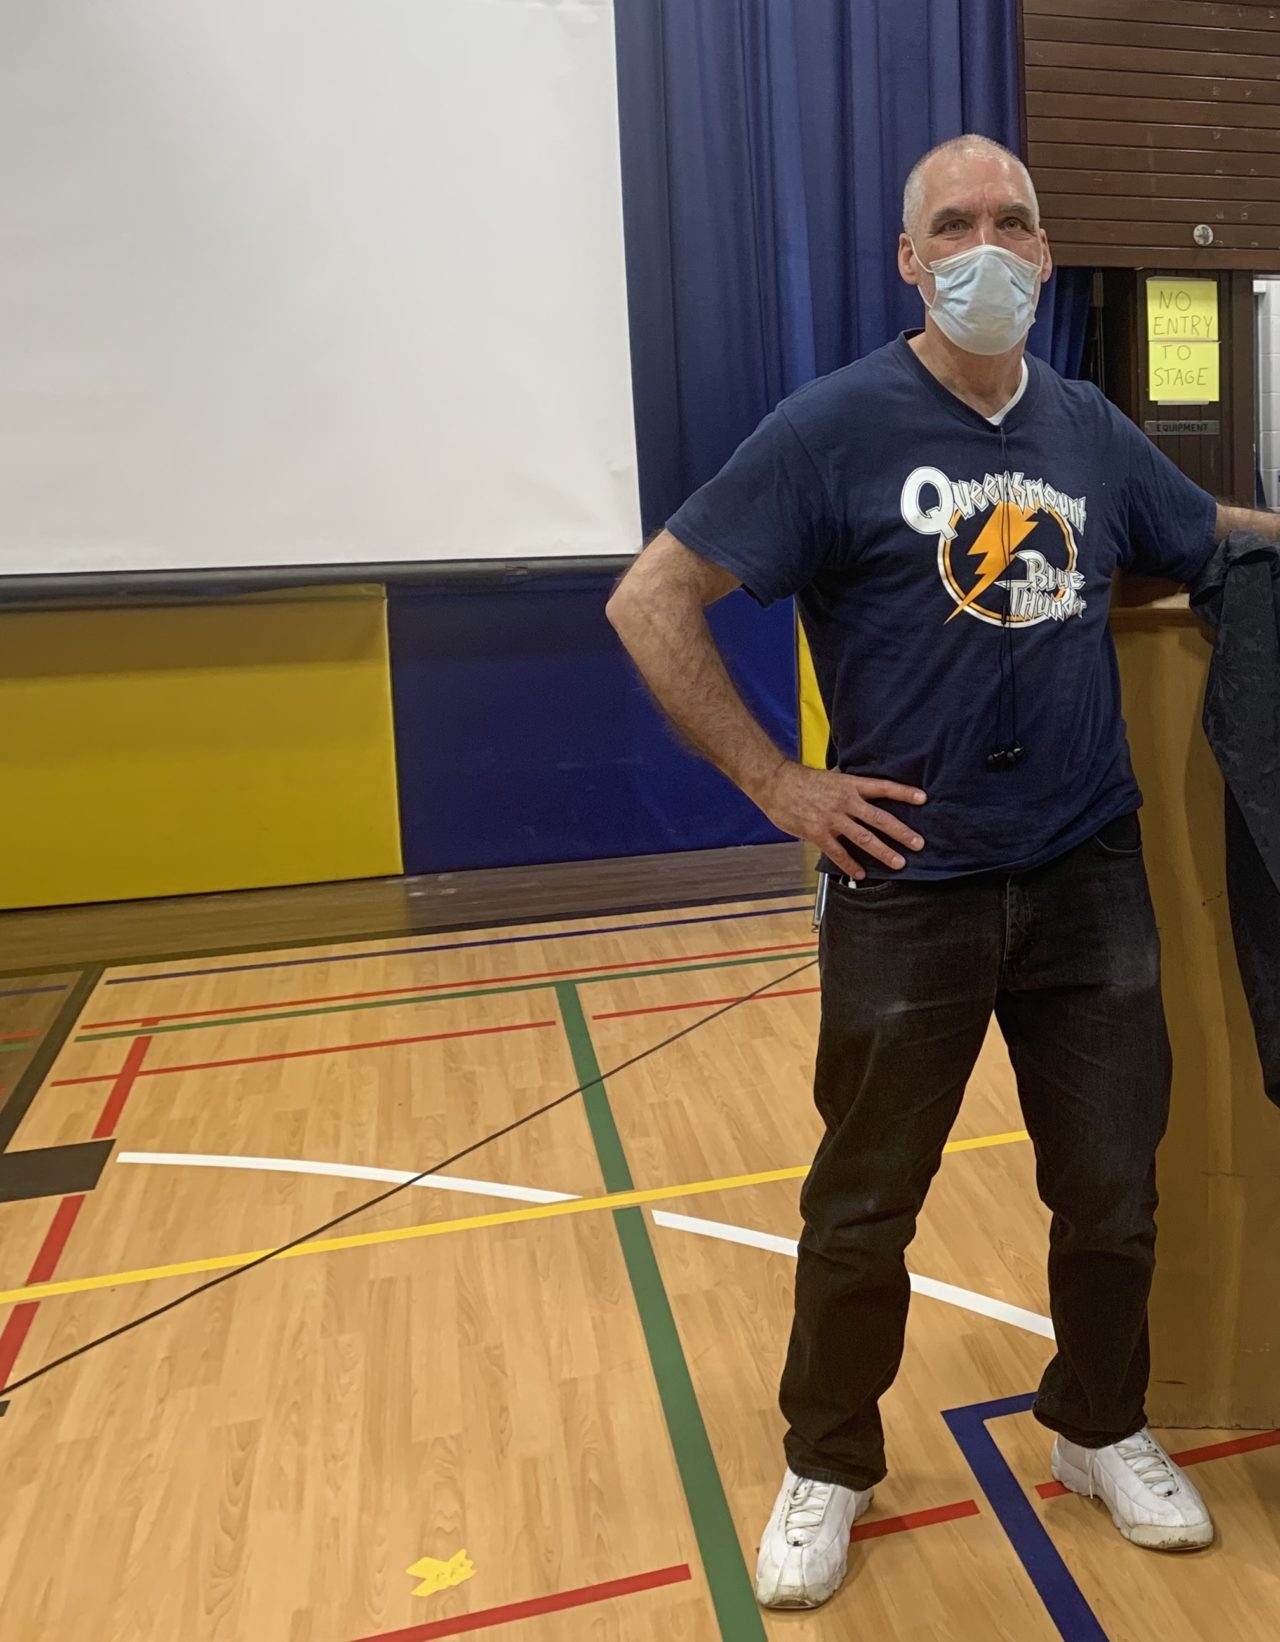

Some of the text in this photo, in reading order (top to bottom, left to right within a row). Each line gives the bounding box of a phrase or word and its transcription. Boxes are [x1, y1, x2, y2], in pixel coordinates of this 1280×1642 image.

[1159, 290, 1192, 312] NO
[1153, 315, 1214, 337] ENTRY
[1161, 344, 1192, 361] TO
[1153, 367, 1209, 387] STAGE
[1156, 422, 1210, 433] EQUIPMENT
